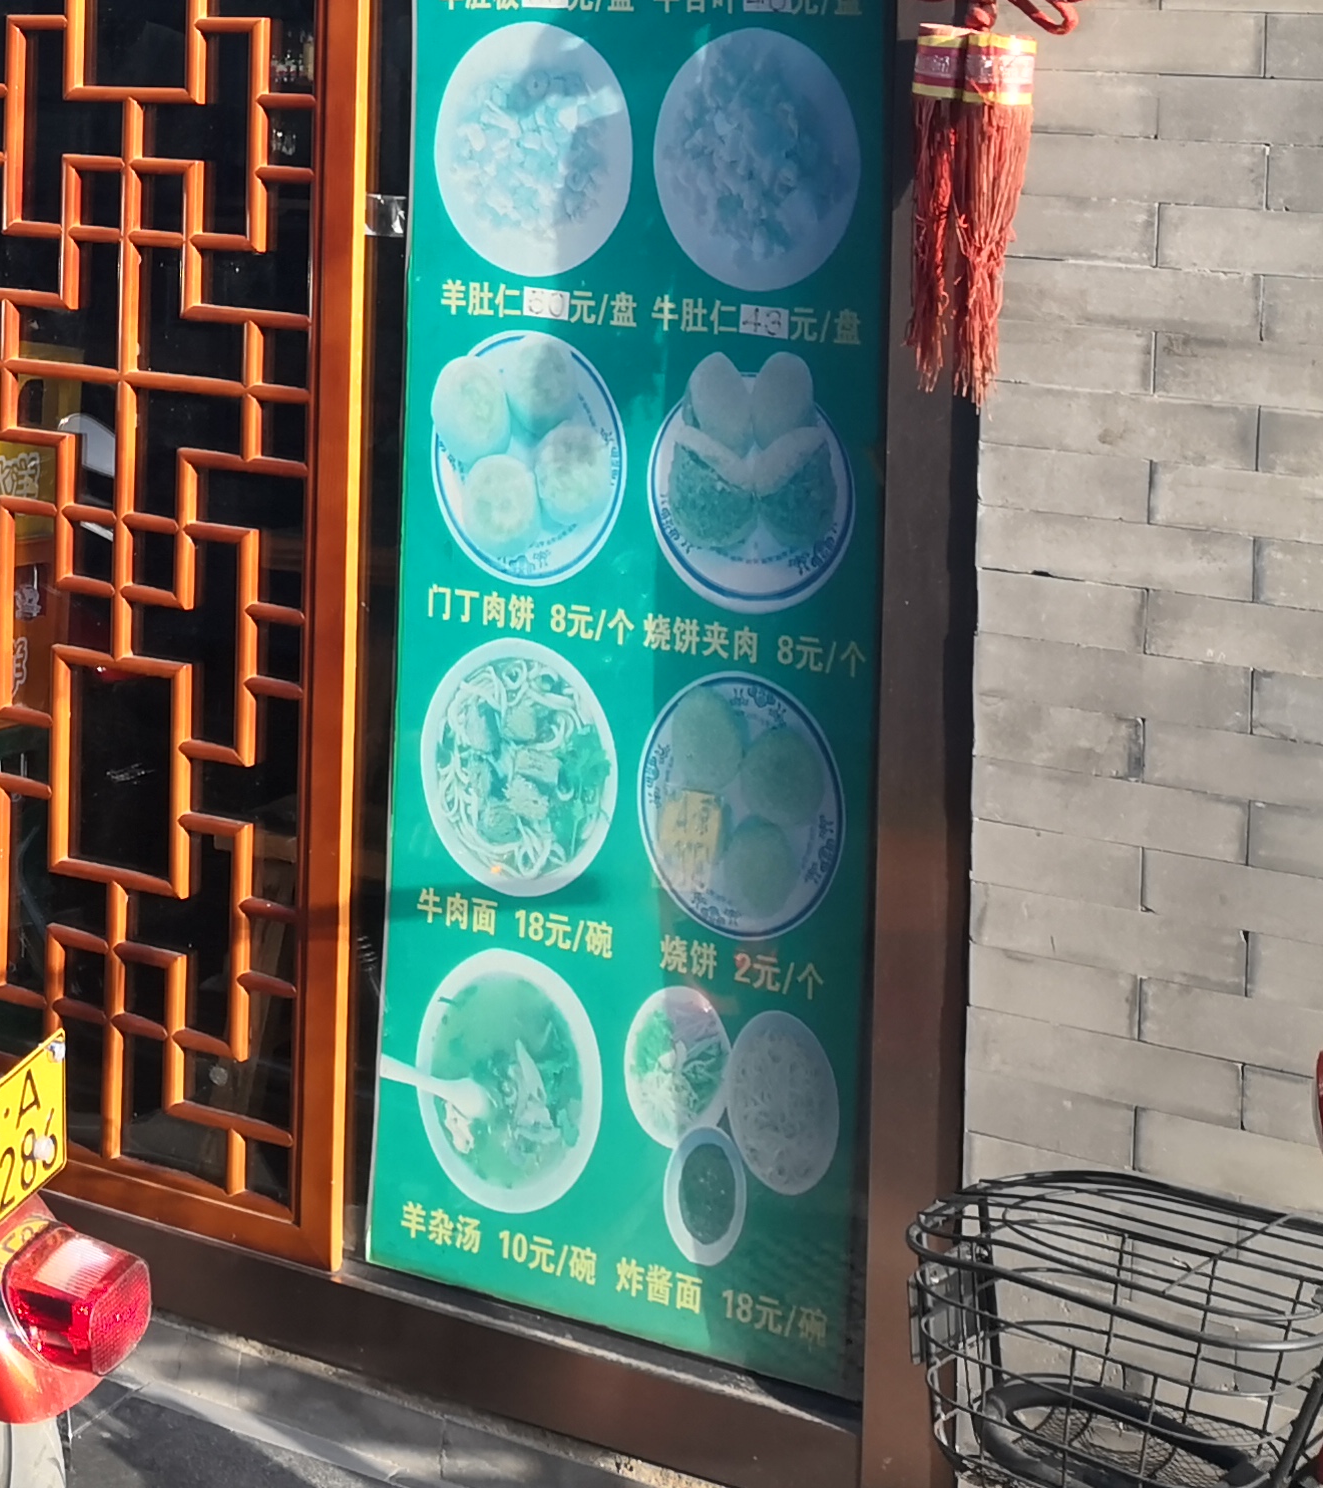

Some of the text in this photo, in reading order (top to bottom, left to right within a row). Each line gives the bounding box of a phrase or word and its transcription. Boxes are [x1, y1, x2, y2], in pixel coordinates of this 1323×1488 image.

[428, 583, 635, 645] 门丁肉饼 8元/个
[643, 612, 867, 678] 烧饼夹肉 8元/个
[416, 886, 614, 959] 牛肉面 18元/碗
[659, 934, 824, 1001] 烧饼 2元/个
[401, 1200, 598, 1286] 羊杂汤 10元/碗
[616, 1257, 828, 1346] 炸酱面 18元/碗
